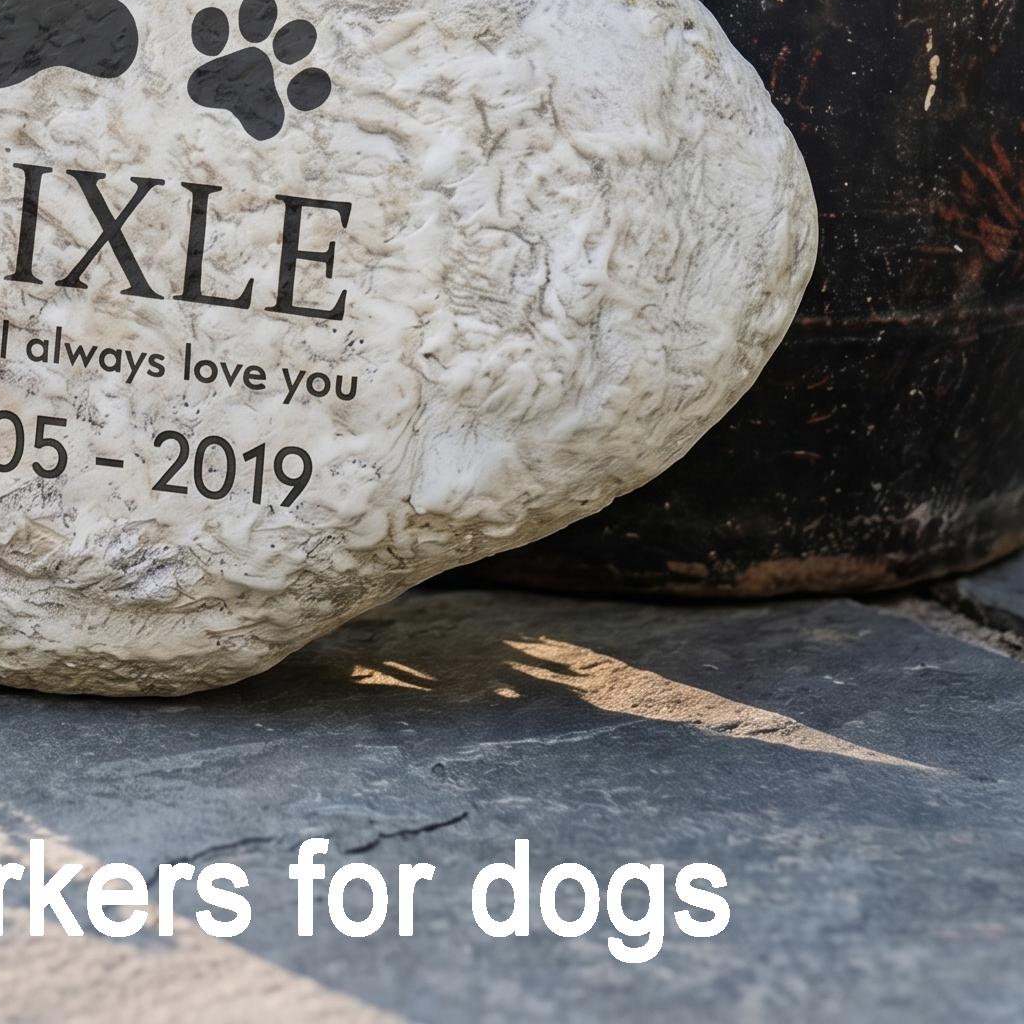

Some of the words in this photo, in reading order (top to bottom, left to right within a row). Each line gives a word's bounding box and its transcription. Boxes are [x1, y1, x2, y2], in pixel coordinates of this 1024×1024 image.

[26, 326, 166, 385] always
[184, 342, 267, 391] love
[282, 367, 358, 405] you
[151, 430, 313, 508] 2019
